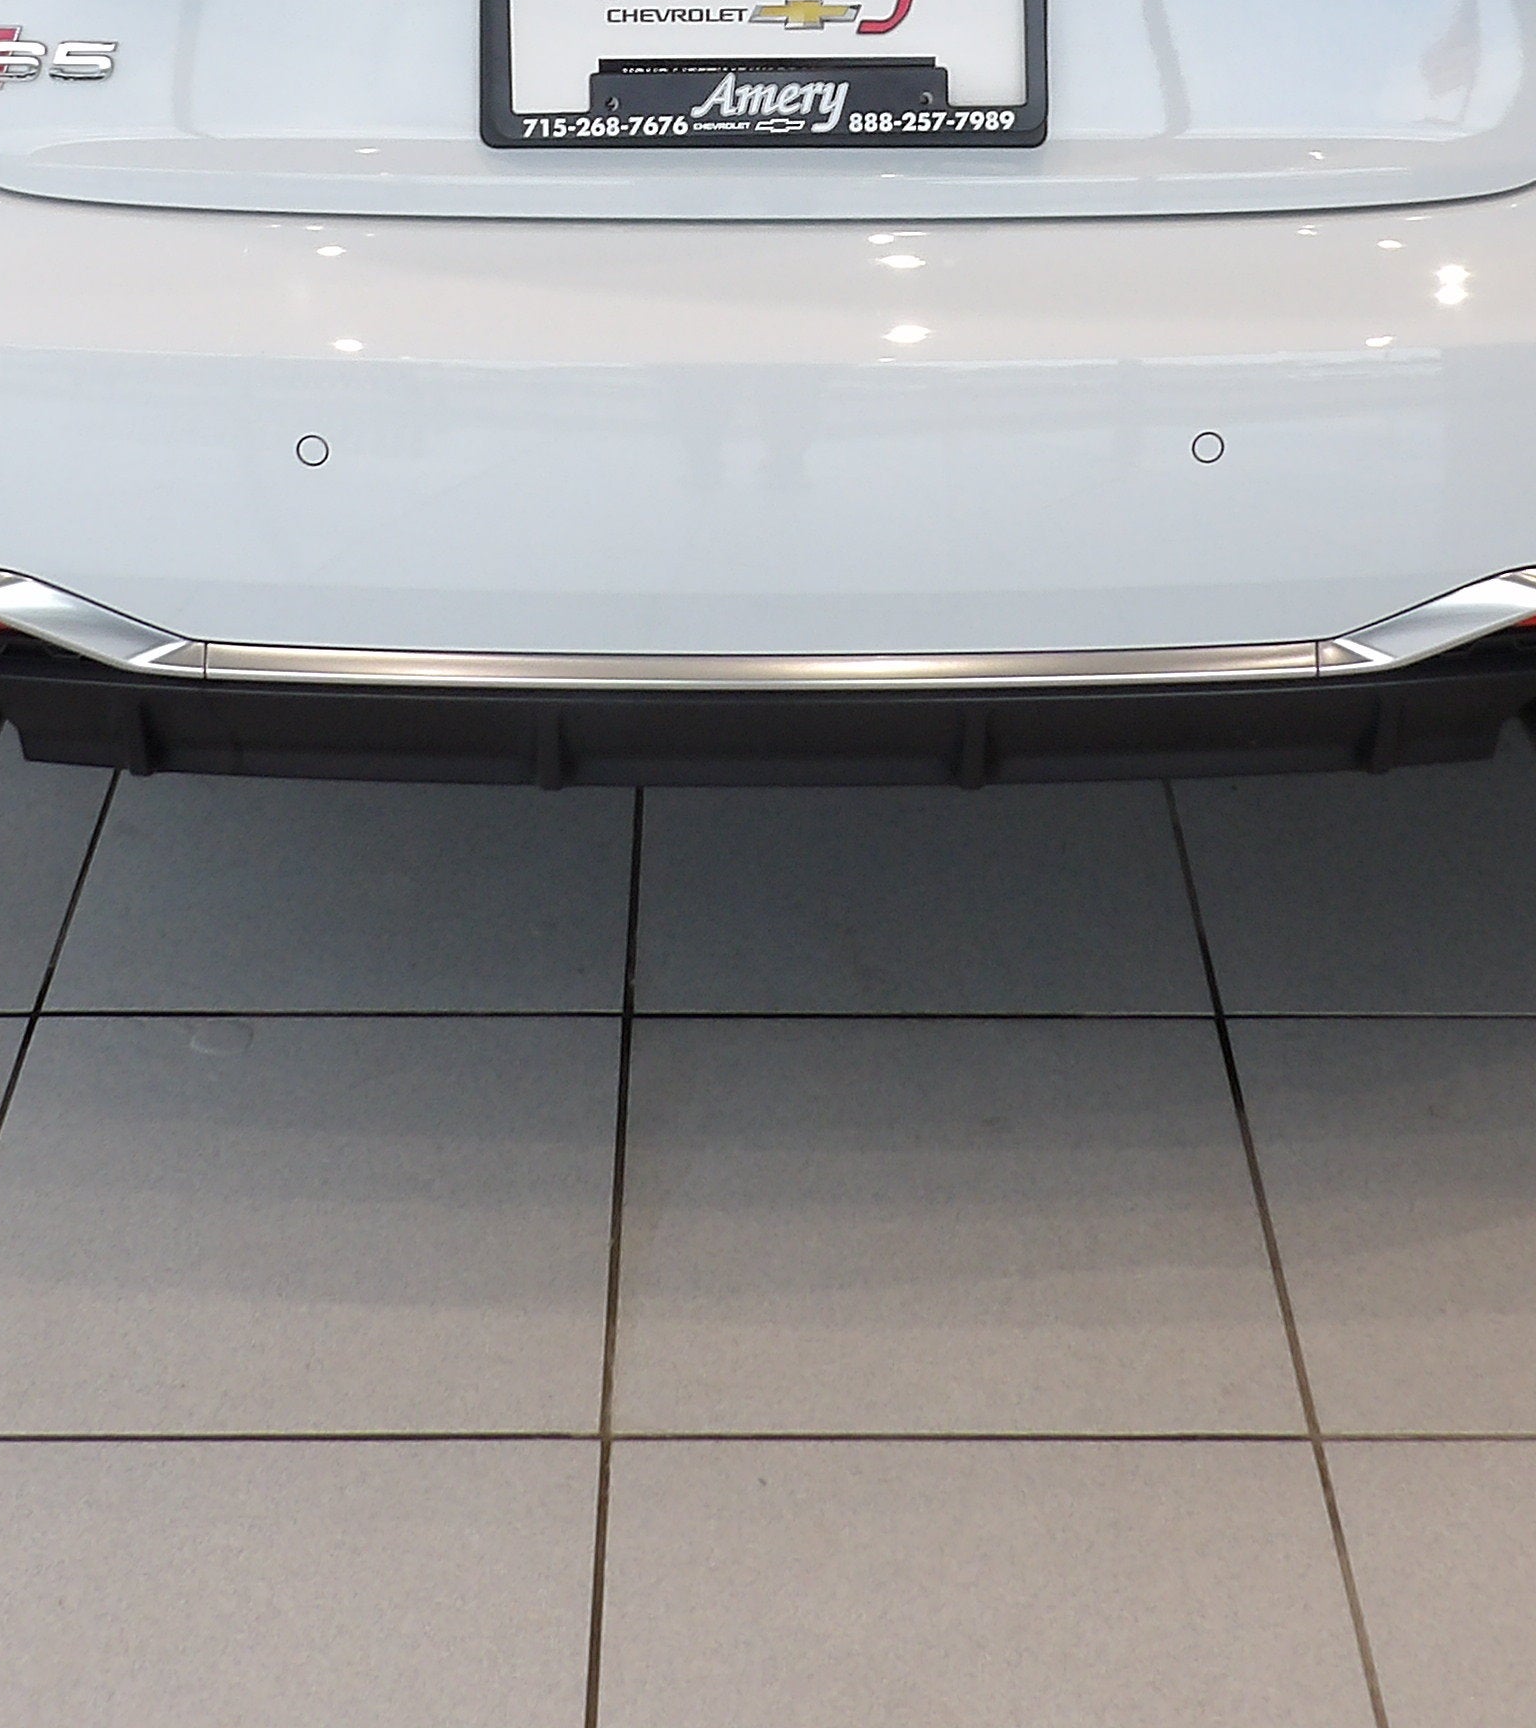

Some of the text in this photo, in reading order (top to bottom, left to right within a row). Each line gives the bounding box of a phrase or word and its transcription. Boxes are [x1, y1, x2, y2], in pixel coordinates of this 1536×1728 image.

[606, 8, 748, 24] CHEVROLET
[691, 72, 849, 133] Amery
[523, 116, 689, 138] 715-268-7676
[693, 121, 750, 131] CHEVROLET
[848, 111, 1016, 133] 888-257-7989
